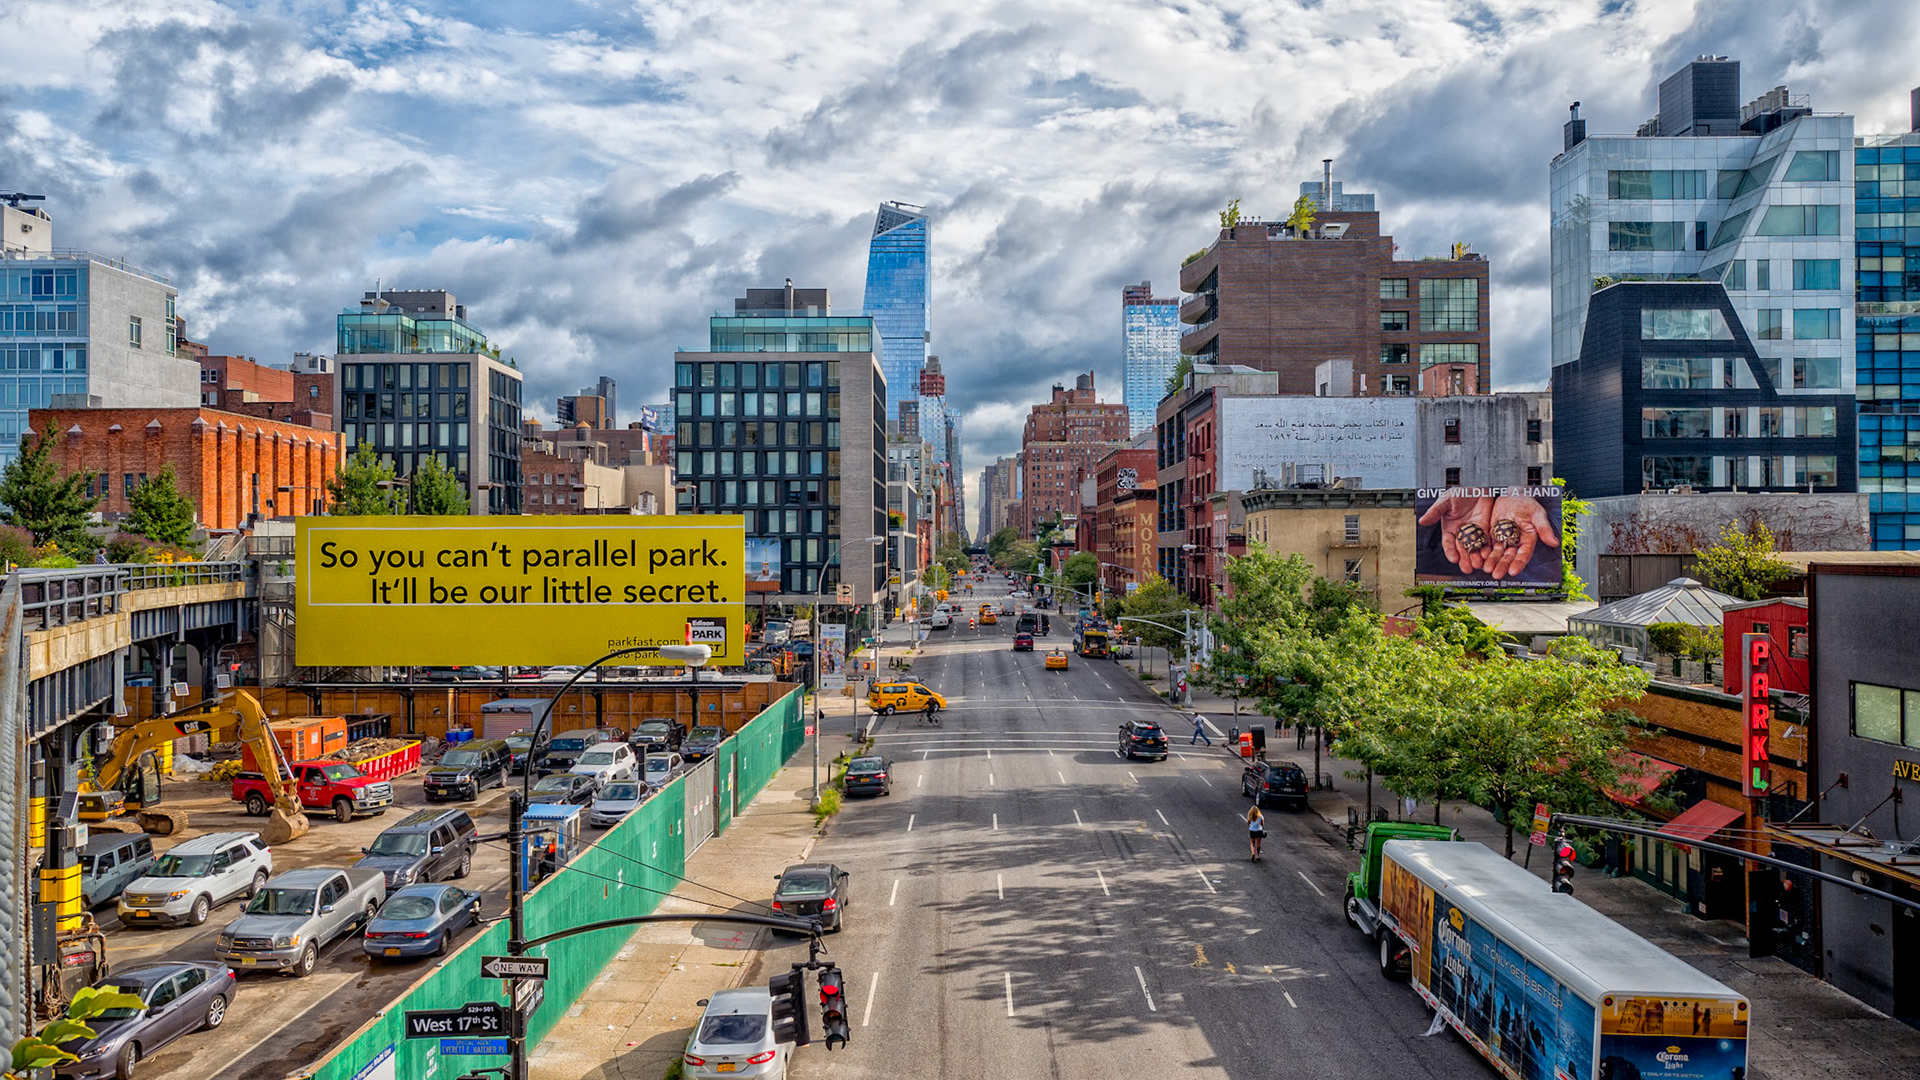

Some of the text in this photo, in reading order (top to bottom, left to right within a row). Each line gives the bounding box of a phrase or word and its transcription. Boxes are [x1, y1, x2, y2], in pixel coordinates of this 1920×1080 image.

[1365, 419, 1389, 430] الكتاب
[1392, 419, 1404, 428] هذا
[1365, 433, 1377, 442] من
[1417, 487, 1560, 498] GIVE WILDLIFE A HAND
[1139, 512, 1154, 582] MORAN
[320, 539, 727, 575] So you can't parallel park.
[430, 576, 468, 604] be
[480, 584, 532, 604] our
[543, 576, 612, 603] little
[623, 580, 728, 603] secret.
[692, 630, 722, 639] PARK
[608, 636, 680, 648] parkfast.com
[1752, 640, 1769, 761] PARK
[183, 721, 200, 734] CAT
[1438, 917, 1472, 962] Corona
[493, 963, 540, 973] ONE WAY
[1445, 948, 1465, 979] Light
[1490, 949, 1509, 968] ONLY
[1510, 964, 1530, 986] GETS
[1531, 980, 1563, 1012] BETTER
[412, 1015, 498, 1033] West 17th St
[1655, 1051, 1689, 1062] Corona
[1664, 1060, 1684, 1070] Light
